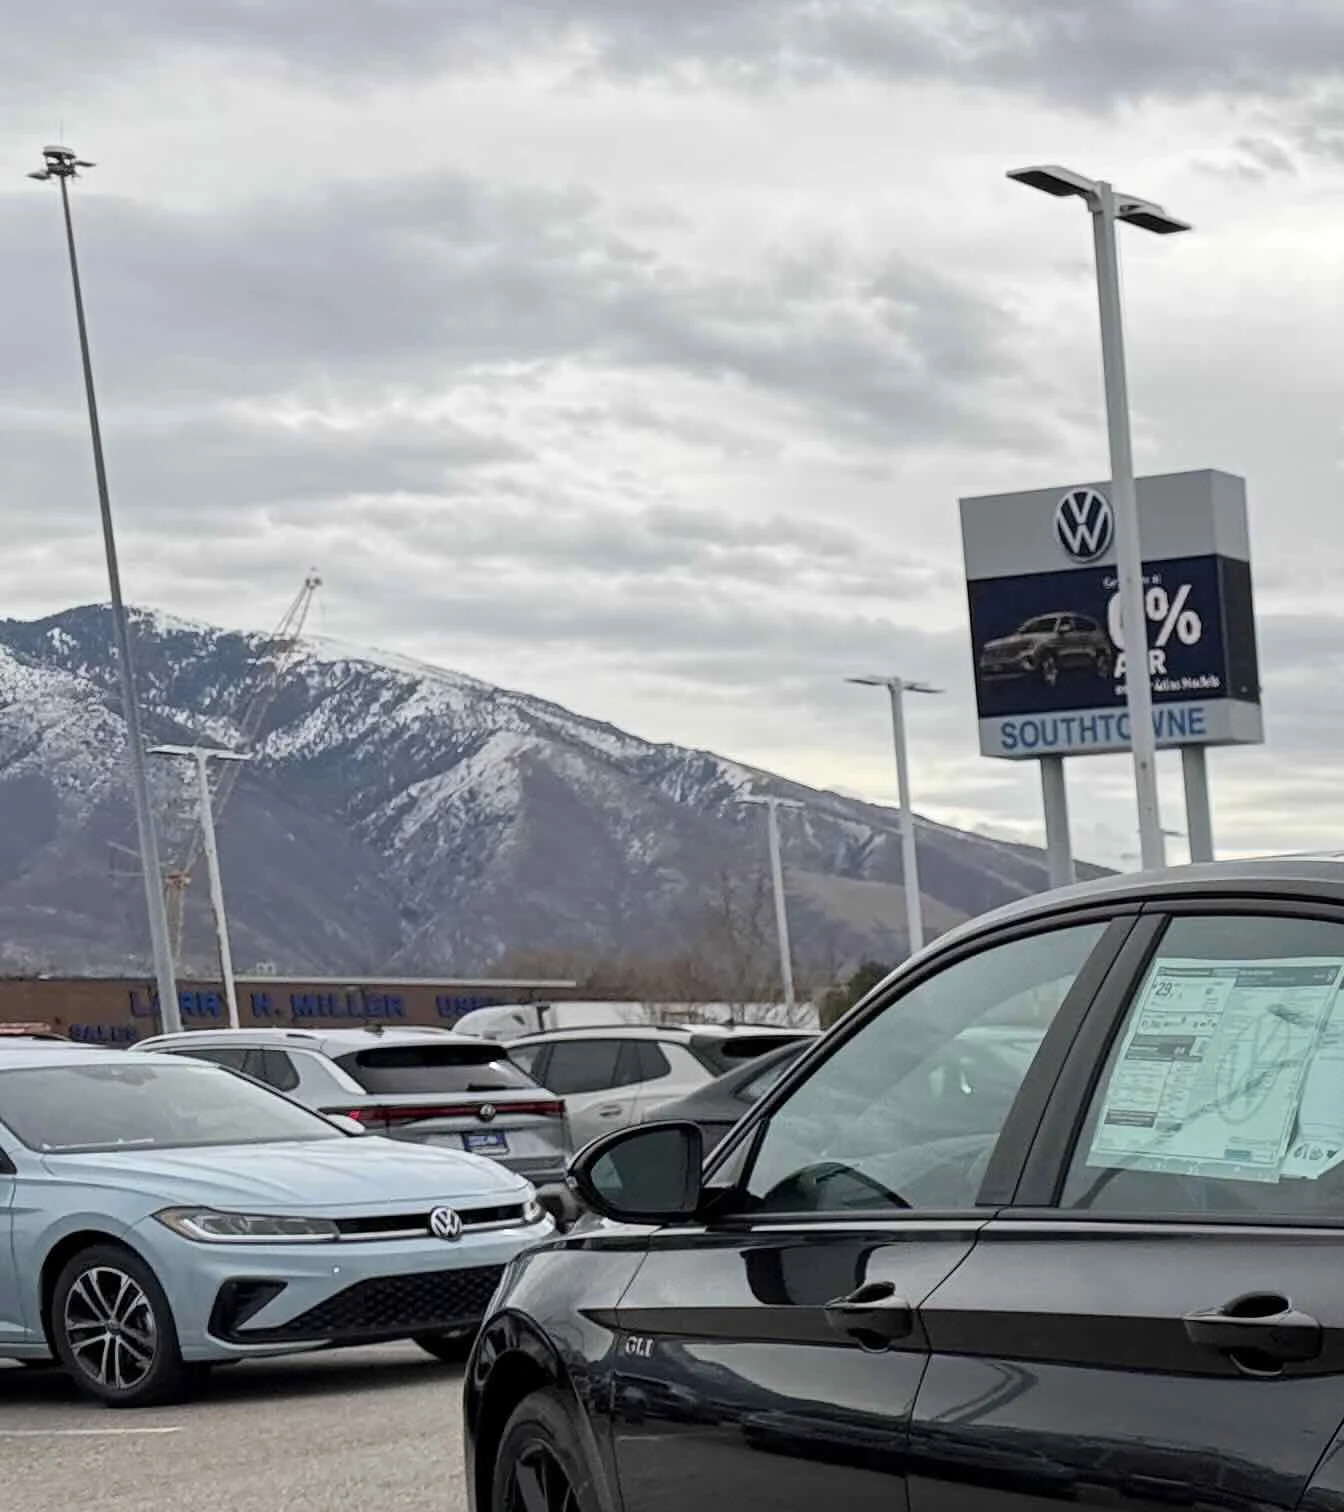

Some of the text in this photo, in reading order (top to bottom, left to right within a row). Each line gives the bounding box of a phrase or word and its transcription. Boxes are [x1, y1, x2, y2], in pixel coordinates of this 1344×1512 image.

[1114, 648, 1167, 678] AR
[129, 990, 225, 1019] LRR
[626, 1336, 655, 1357] GLI
